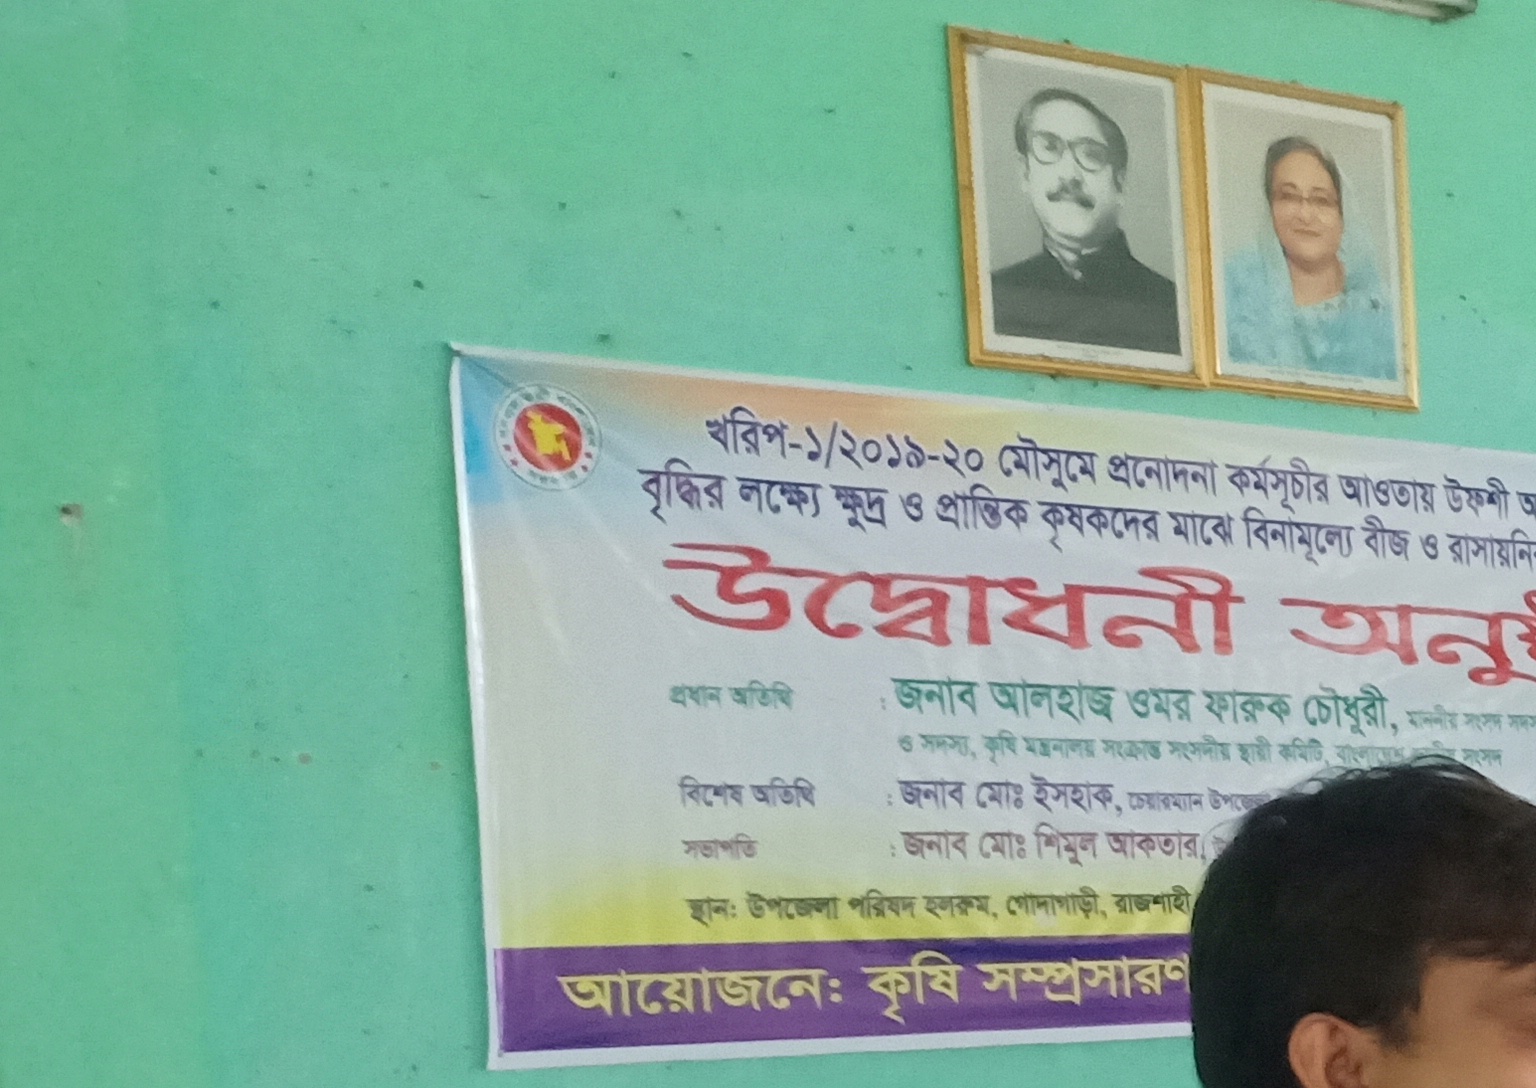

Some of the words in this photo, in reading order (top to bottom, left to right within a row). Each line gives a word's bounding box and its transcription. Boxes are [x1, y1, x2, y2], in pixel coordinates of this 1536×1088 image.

[706, 406, 984, 478] খরিপ-১/২০১৯-২০
[999, 432, 1098, 492] মৌসুমে
[1108, 452, 1218, 496] প্রনোদনা
[1225, 455, 1330, 512] কর্মসূচীর
[1338, 474, 1435, 514] আওতায়
[1444, 474, 1510, 521] উফশী
[637, 457, 727, 525] বৃদ্ধির
[736, 476, 823, 518] লক্ষ্যে
[829, 484, 888, 532] ক্ষুদ্র
[900, 492, 924, 522] ও
[936, 483, 1030, 532] প্রান্তিক
[1037, 501, 1160, 553] কৃষকদের
[1167, 510, 1235, 547] মাঝে
[1241, 506, 1354, 566] বিনামূল্যে
[1361, 514, 1411, 562] বীজ
[1420, 537, 1439, 560] ও
[663, 542, 1245, 655] উদ্বোধনী
[670, 683, 722, 708] প্রধান
[728, 680, 794, 709] অতিথি
[890, 676, 979, 716] জনাব
[1124, 687, 1196, 722] ওমর
[1202, 689, 1292, 725] ফারুক
[1303, 682, 1399, 738] চৌধুরী,
[1463, 711, 1503, 733] সংসদ
[898, 734, 914, 753] ও
[918, 733, 977, 760] সদস্য,
[981, 729, 1018, 765] কৃষি
[1167, 735, 1232, 762] সংসদীয়
[678, 775, 745, 807] বিশেষ
[749, 777, 816, 808] অতিথি
[898, 777, 966, 810] জনাব
[976, 778, 1024, 811] মোঃ
[1030, 772, 1124, 818] ইসহাক,
[682, 833, 758, 860] সভাপতি
[900, 829, 970, 861] জনাব
[979, 830, 1027, 860] মোঃ
[1033, 822, 1100, 867] শিমুল
[746, 891, 840, 921] উপজেলা
[848, 887, 917, 921] পরিষদ
[923, 892, 998, 922] হলরুম,
[1005, 885, 1107, 920] গোদাগাড়ী,
[863, 950, 963, 1026] কৃষি
[976, 952, 1191, 1006] সম্প্রসারণ
